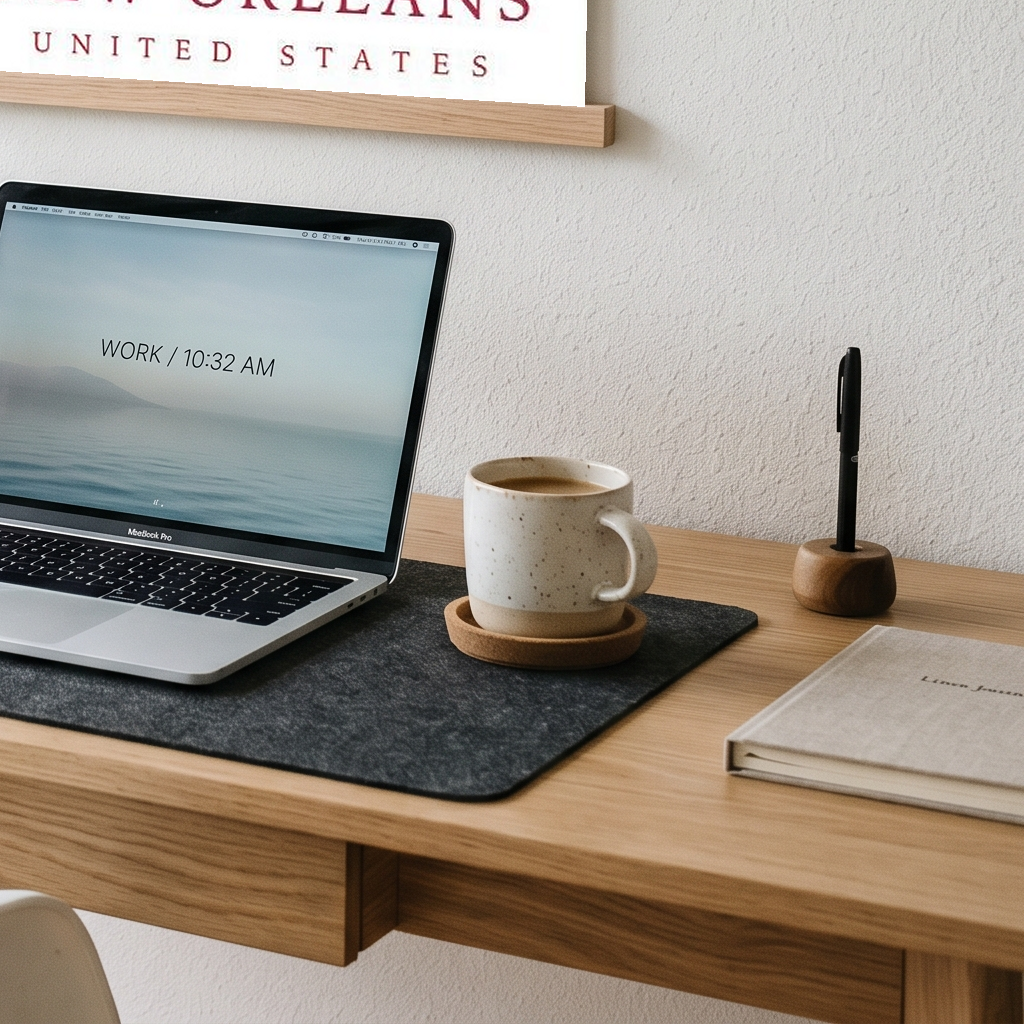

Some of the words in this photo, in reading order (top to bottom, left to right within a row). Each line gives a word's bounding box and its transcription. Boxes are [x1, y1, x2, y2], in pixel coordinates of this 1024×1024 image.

[33, 31, 232, 63] UNITED
[281, 44, 488, 78] STATES
[101, 338, 164, 364] WORK
[166, 346, 179, 367] /
[183, 348, 236, 373] 10:32
[239, 356, 275, 378] AM
[160, 532, 173, 542] Pro
